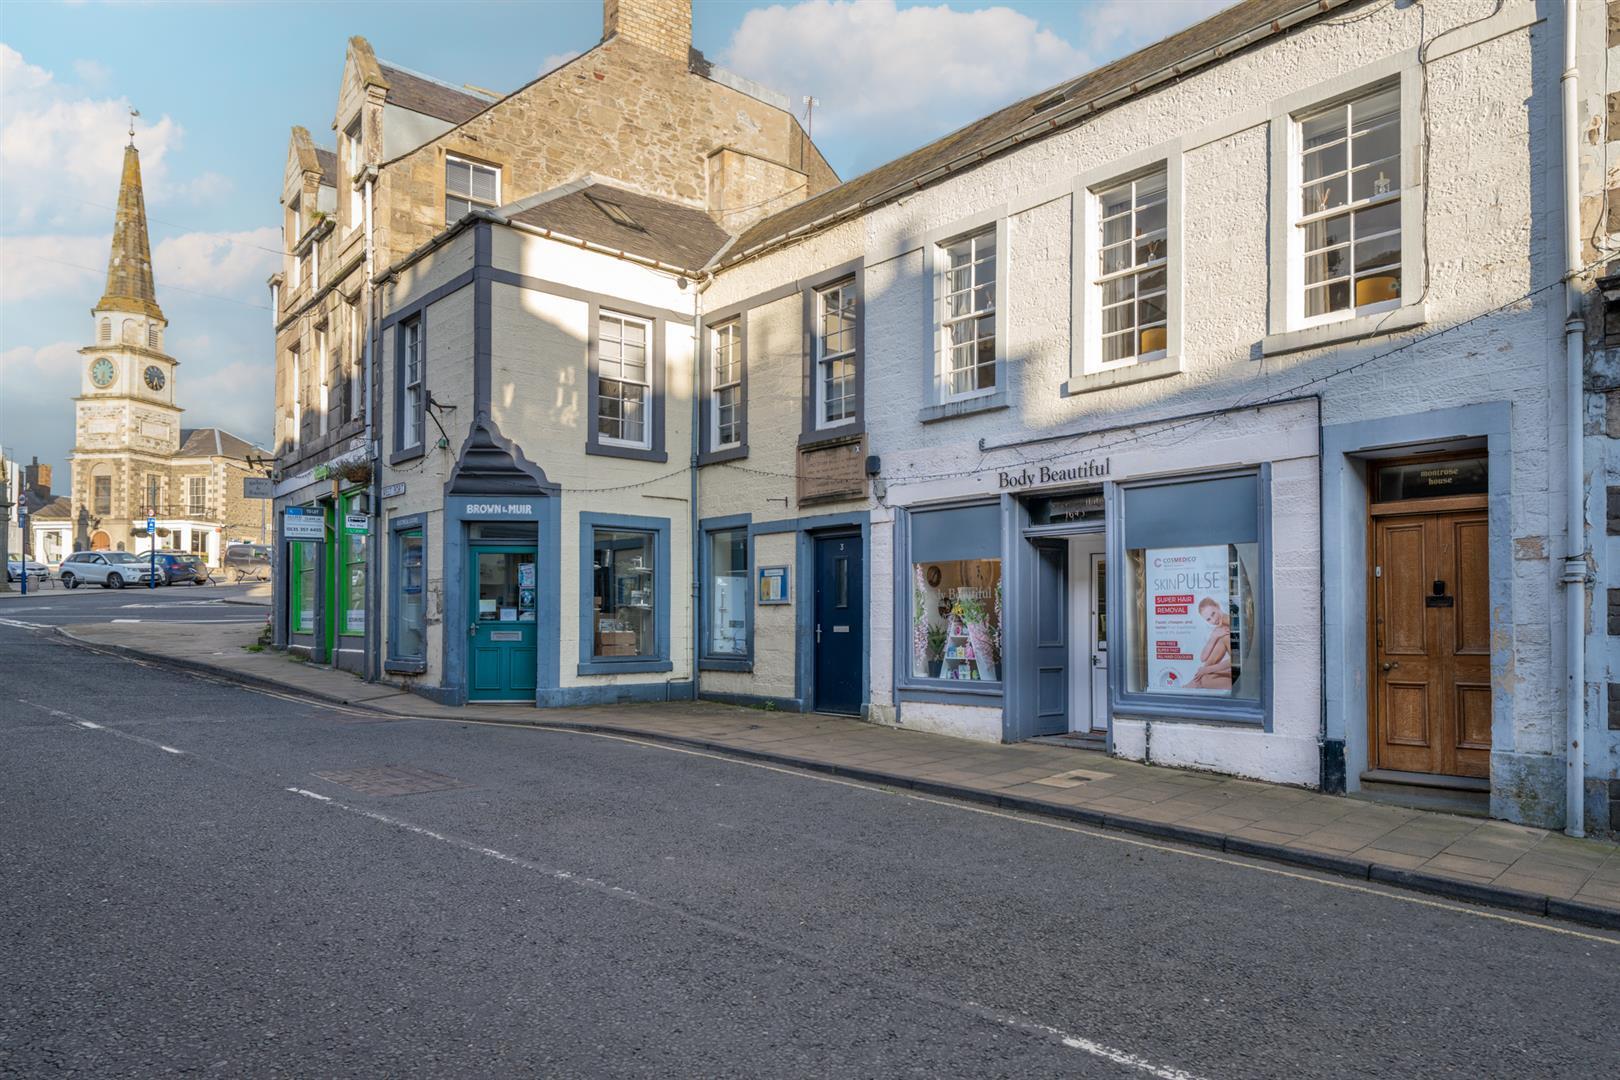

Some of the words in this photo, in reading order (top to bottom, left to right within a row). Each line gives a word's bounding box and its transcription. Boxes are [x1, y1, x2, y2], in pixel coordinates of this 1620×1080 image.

[998, 469, 1036, 488] Body
[1039, 457, 1111, 483] Beautiful
[1420, 467, 1459, 477] montrose
[1428, 477, 1453, 486] house
[466, 504, 501, 514] BROWN
[508, 504, 532, 514] MUIR
[1156, 596, 1177, 604] SUPER
[1177, 595, 1193, 603] HAIR
